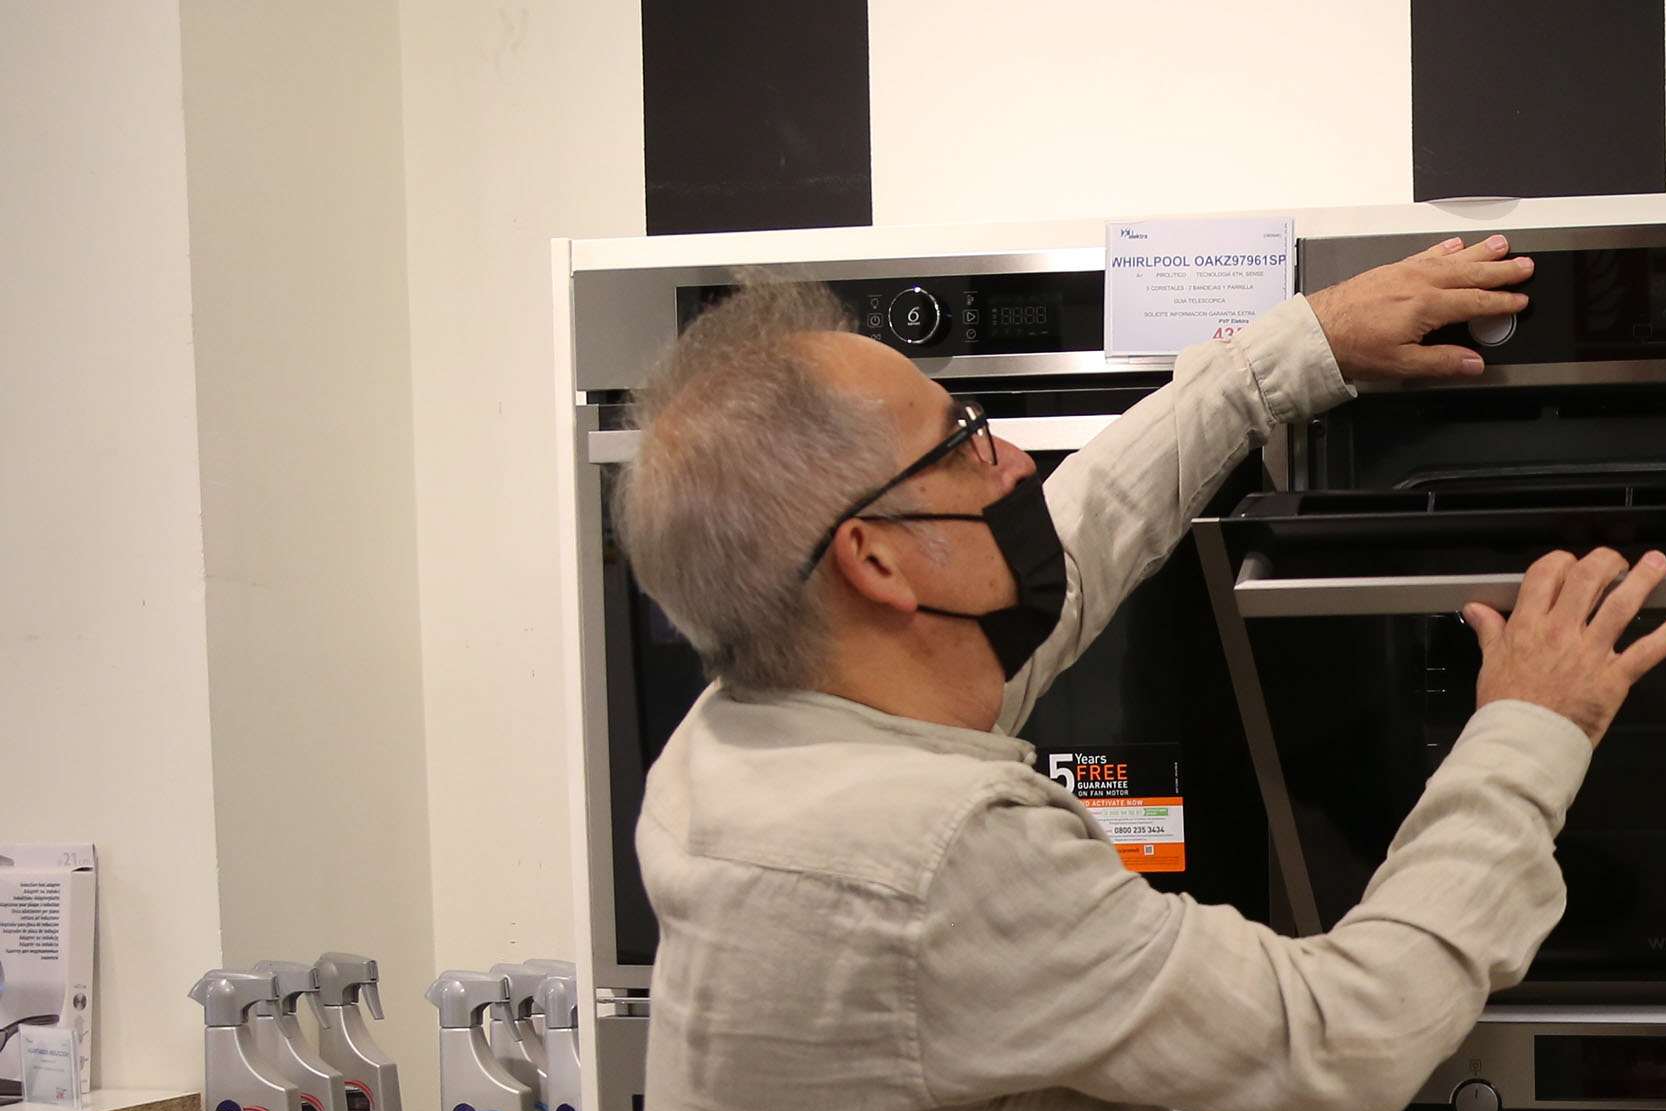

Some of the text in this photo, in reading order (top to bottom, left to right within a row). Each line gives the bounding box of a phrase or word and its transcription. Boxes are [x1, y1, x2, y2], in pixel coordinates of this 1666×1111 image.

[1112, 254, 1287, 268] WHIRLPOOL OAKZ97961SP
[1049, 753, 1107, 796] 5 Years
[1076, 764, 1128, 781] FREE
[1077, 781, 1129, 790] GUARANTEE
[1147, 826, 1165, 834] 3434
